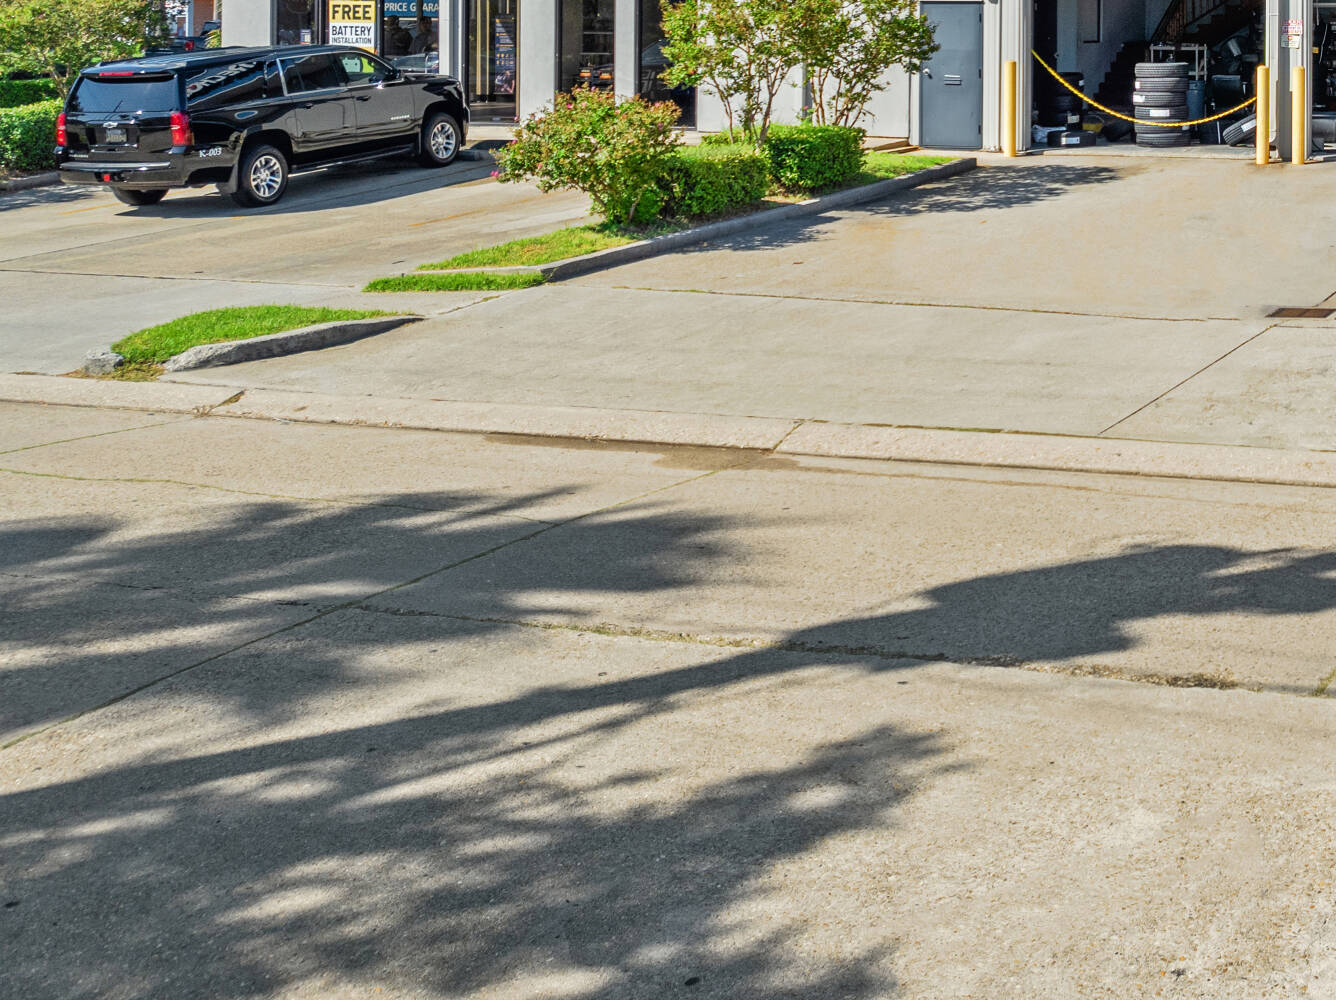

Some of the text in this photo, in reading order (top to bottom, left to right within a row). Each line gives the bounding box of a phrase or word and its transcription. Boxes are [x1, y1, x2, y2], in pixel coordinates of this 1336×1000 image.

[331, 4, 372, 21] FREE
[384, 2, 439, 12] PRICE GARA
[331, 25, 372, 36] BATTERY
